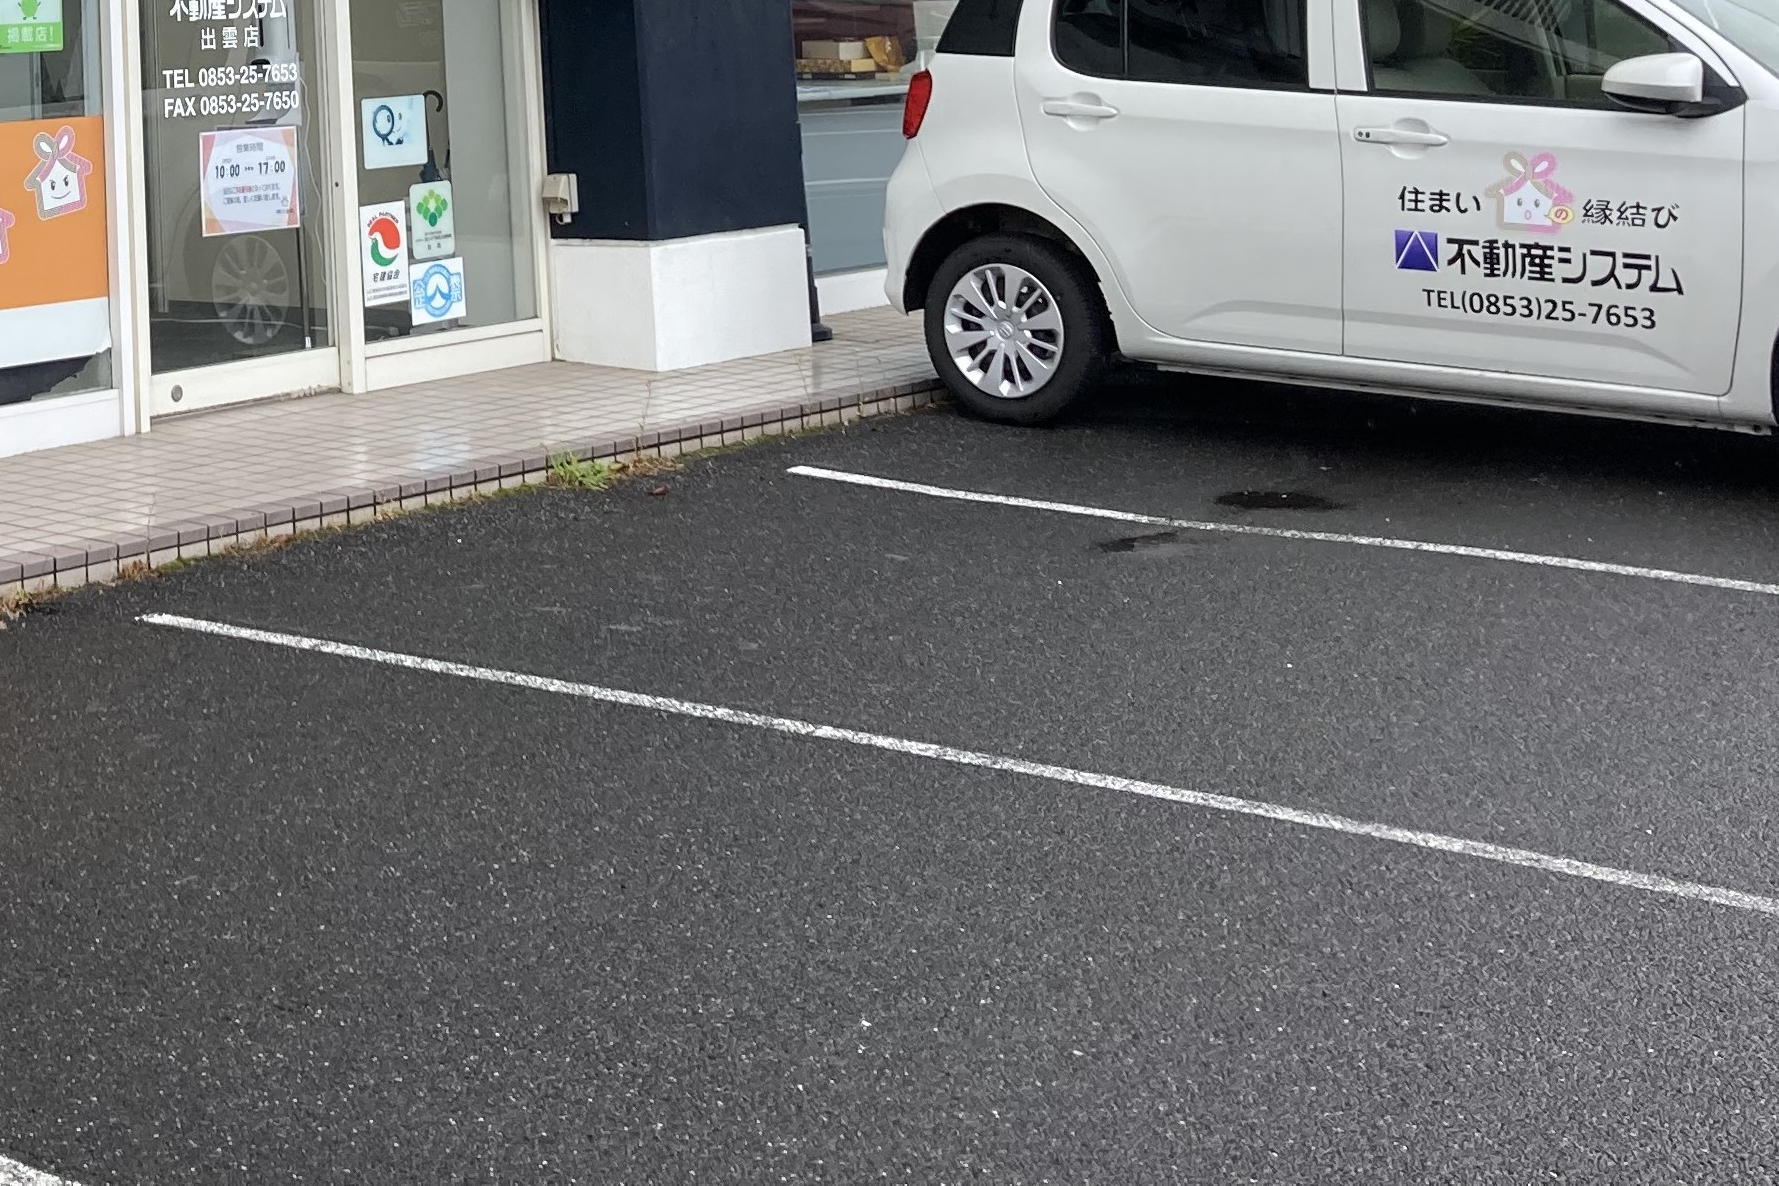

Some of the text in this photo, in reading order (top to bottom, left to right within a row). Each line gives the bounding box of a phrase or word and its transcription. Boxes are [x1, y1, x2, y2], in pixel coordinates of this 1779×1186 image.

[201, 25, 259, 50] 出雲店
[162, 63, 298, 89] TEL 0853-25-7653
[164, 90, 300, 118] FAX 0853-25-7650
[1398, 186, 1481, 214] 住まい
[1581, 198, 1680, 229] 縁結び
[1446, 237, 1684, 296] 不動産システム
[1422, 288, 1657, 330] TEL(0853)25-7653
